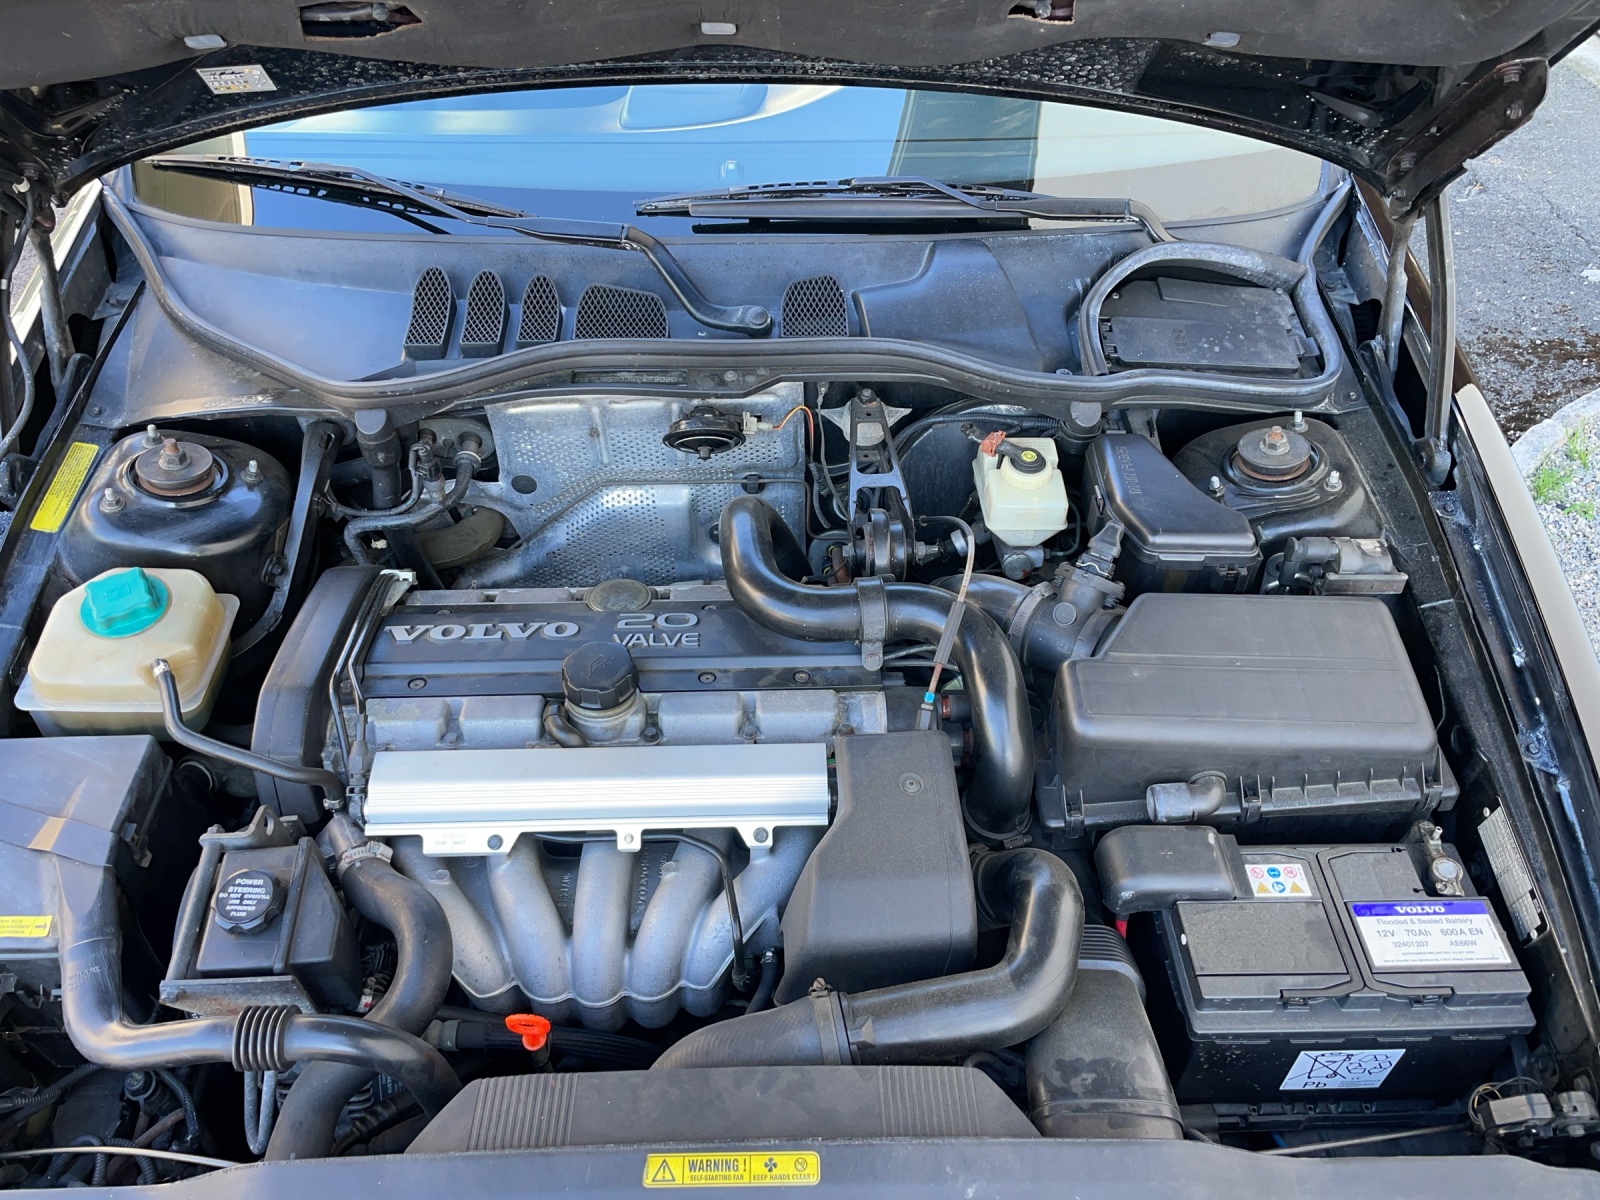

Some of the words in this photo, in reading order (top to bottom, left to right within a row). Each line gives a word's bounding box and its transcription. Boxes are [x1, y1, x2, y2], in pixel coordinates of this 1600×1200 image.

[616, 612, 699, 630] 20
[383, 621, 580, 645] VOLVO
[612, 632, 700, 648] VALVE
[235, 878, 264, 886] POWER
[227, 886, 266, 894] STEERING
[1394, 905, 1446, 914] VOLVO
[1445, 917, 1473, 925] Battery
[1376, 930, 1395, 938] 12V
[1468, 928, 1484, 936] EN
[1302, 1081, 1327, 1089] Pb
[687, 1158, 739, 1173] WARNING
[743, 1158, 747, 1172] !
[689, 1174, 732, 1182] SELF-STARTING
